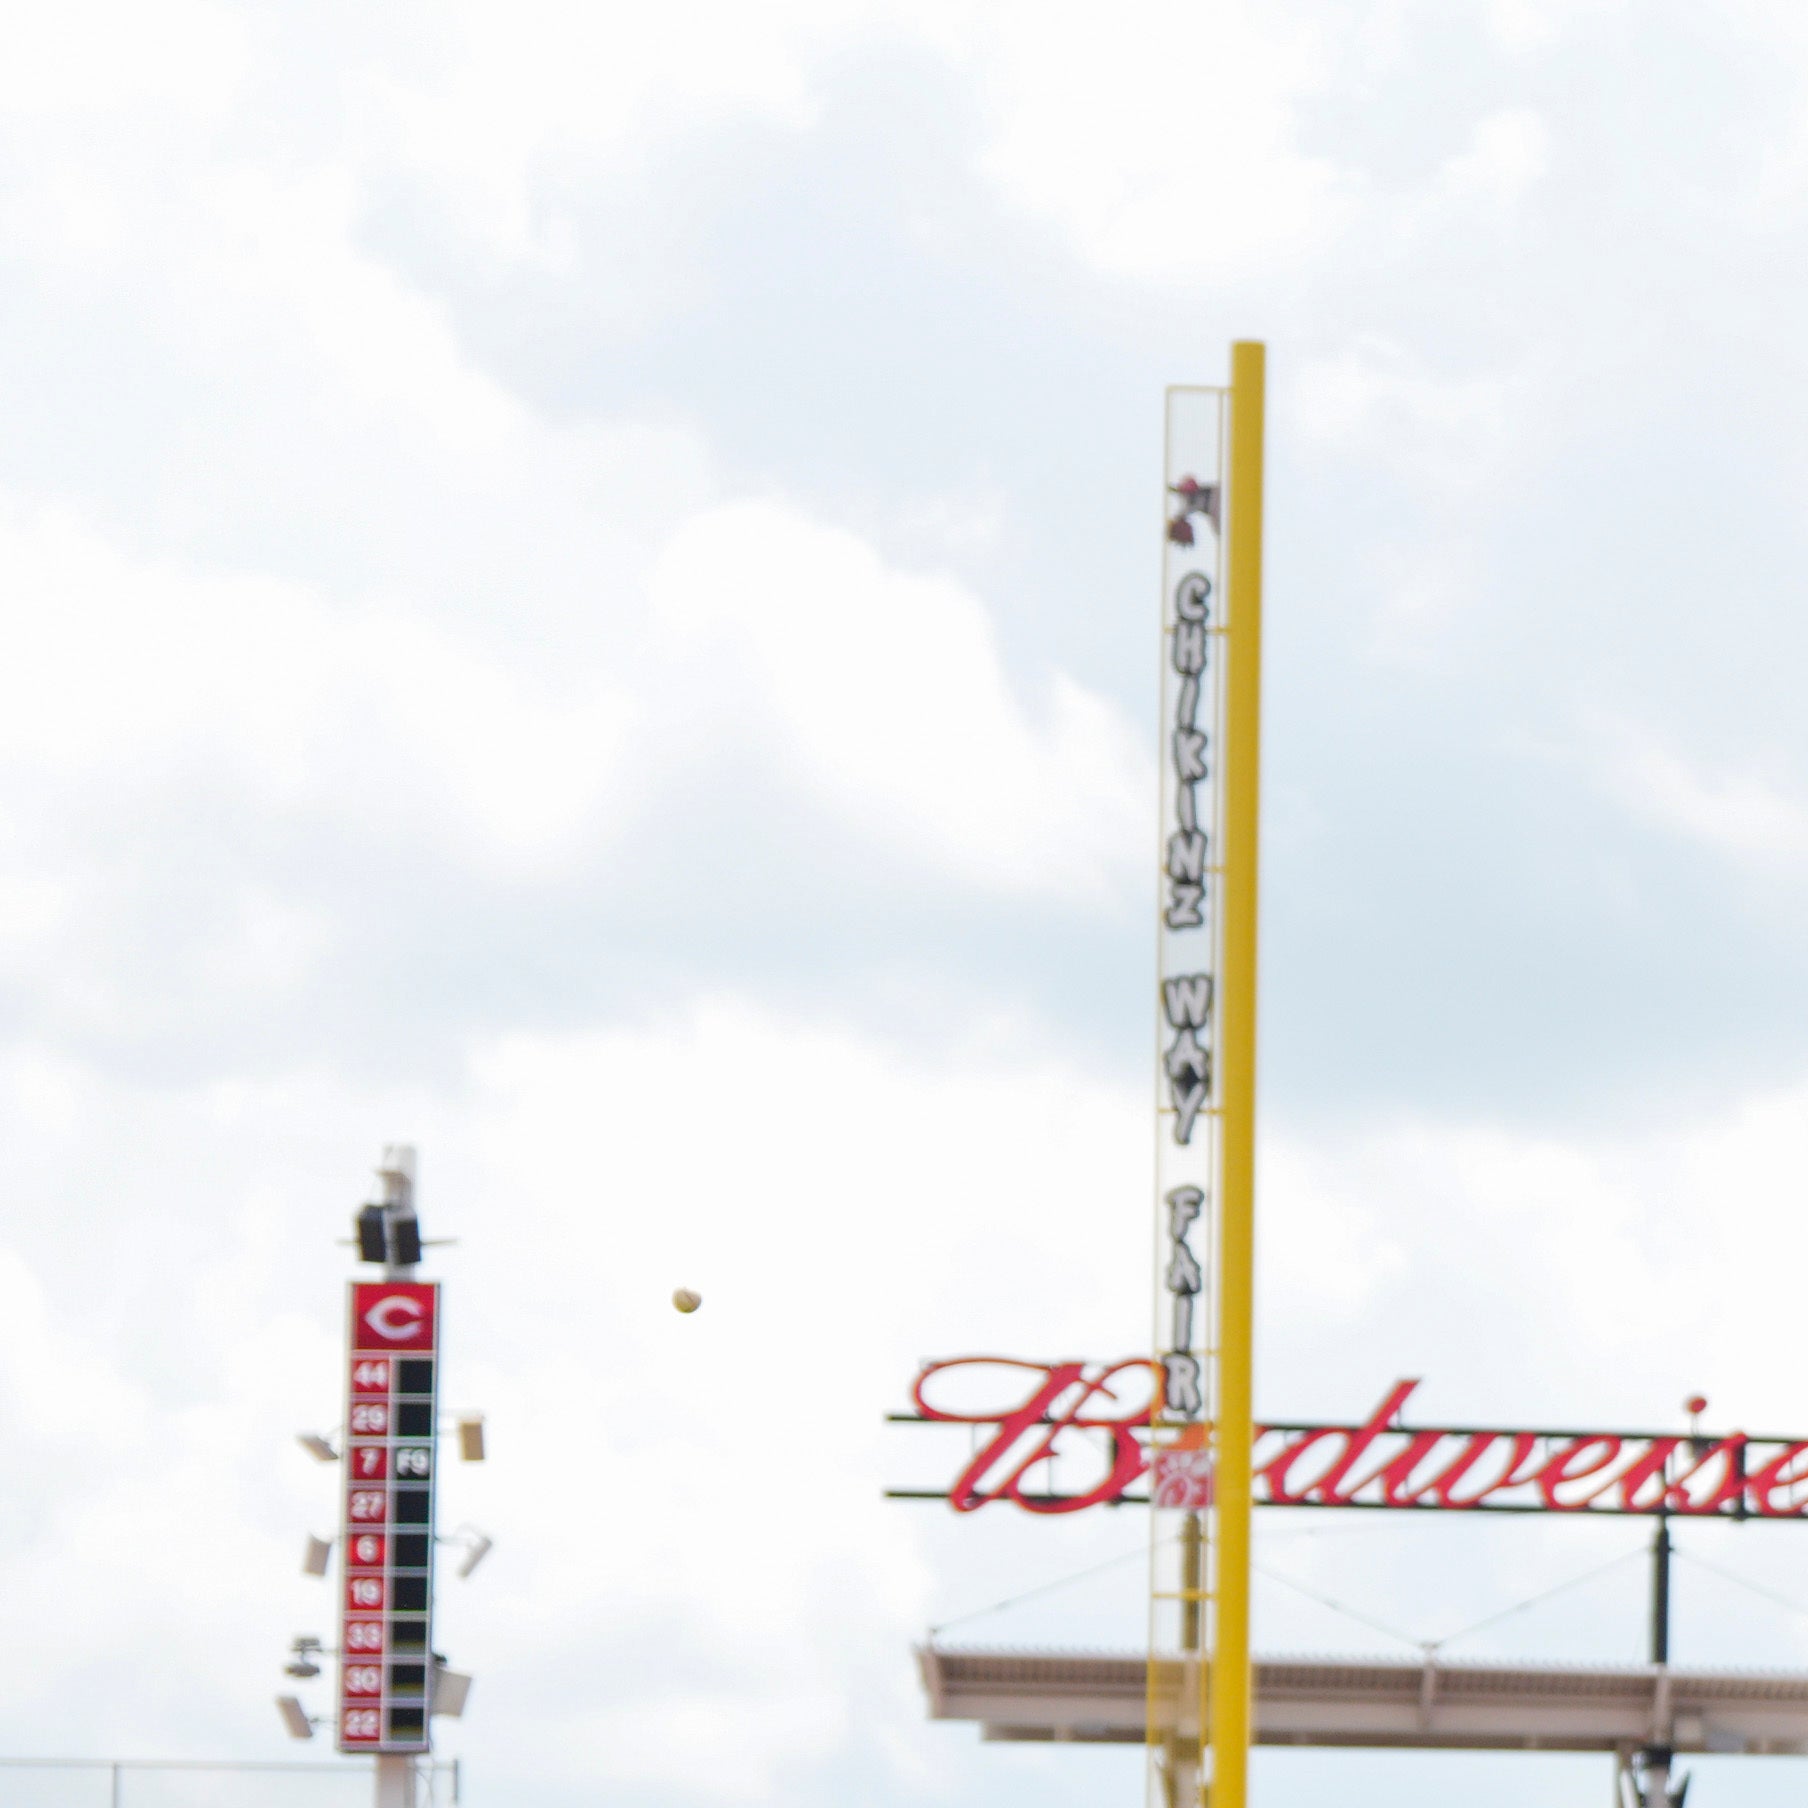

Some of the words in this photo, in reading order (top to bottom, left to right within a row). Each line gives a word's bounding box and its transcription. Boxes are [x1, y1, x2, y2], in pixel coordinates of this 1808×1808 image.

[1162, 974, 1214, 1146] WAY
[353, 1361, 387, 1388] 44
[360, 1448, 379, 1475] 7
[351, 1491, 384, 1519] 27
[357, 1535, 377, 1563] 6
[346, 1665, 378, 1692] 30
[346, 1709, 377, 1735] 22
